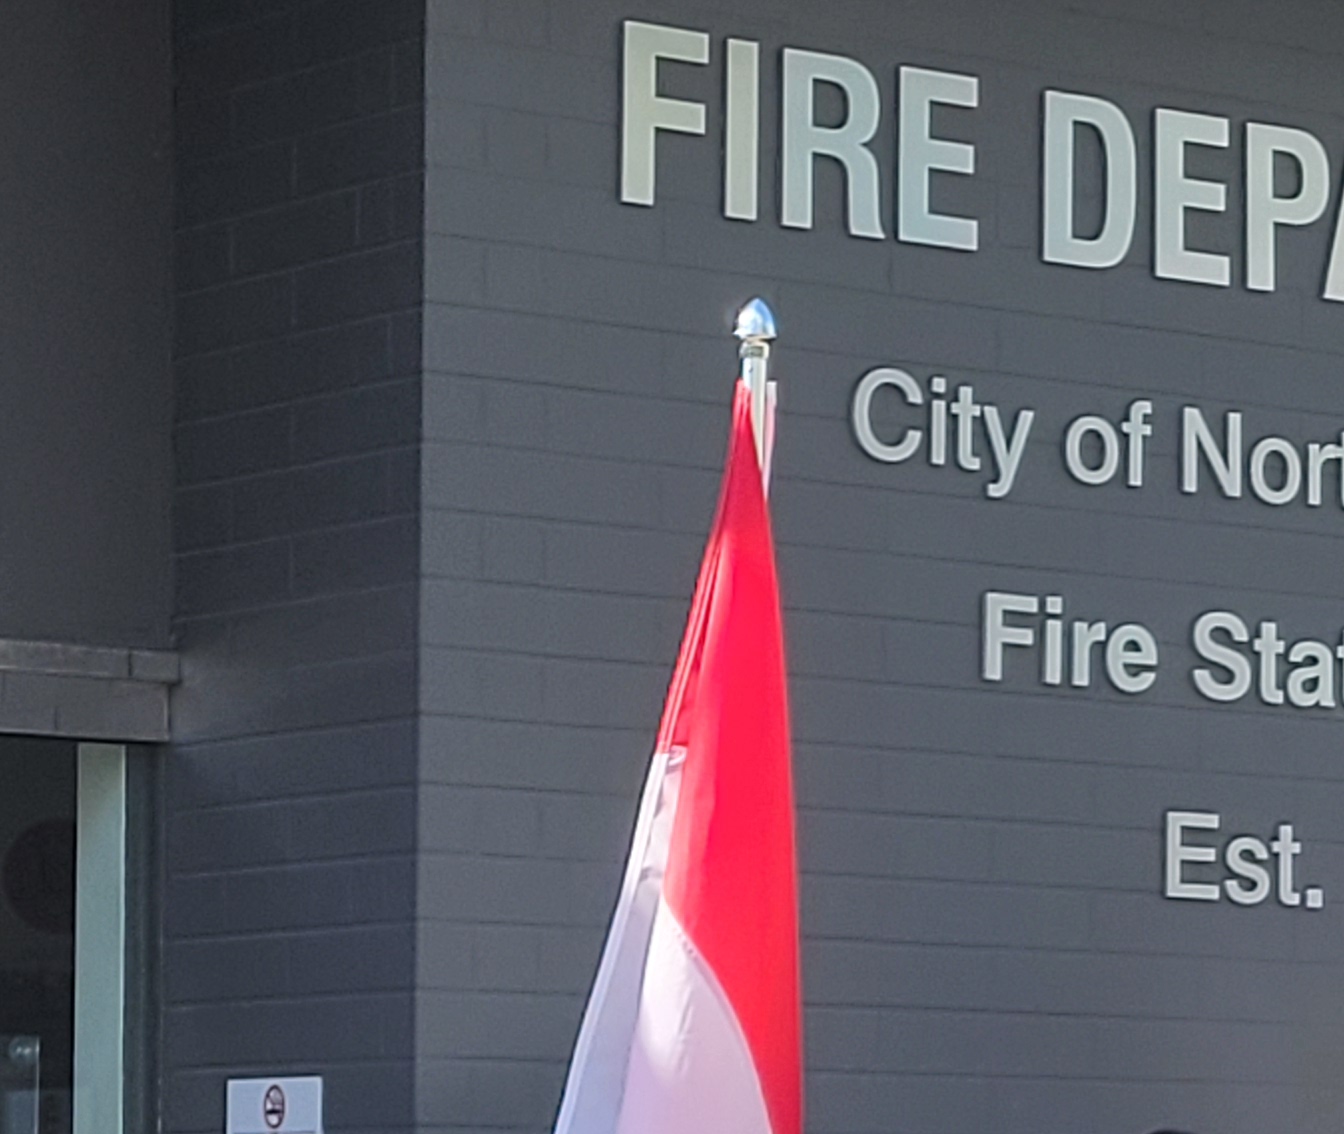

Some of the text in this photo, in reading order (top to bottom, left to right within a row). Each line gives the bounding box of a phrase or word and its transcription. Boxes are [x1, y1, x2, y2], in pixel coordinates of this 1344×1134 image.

[620, 18, 979, 254] FIRE
[852, 367, 1034, 498] City
[1064, 402, 1153, 487] of
[981, 590, 1159, 693] Fire
[1163, 809, 1324, 909] Est.
